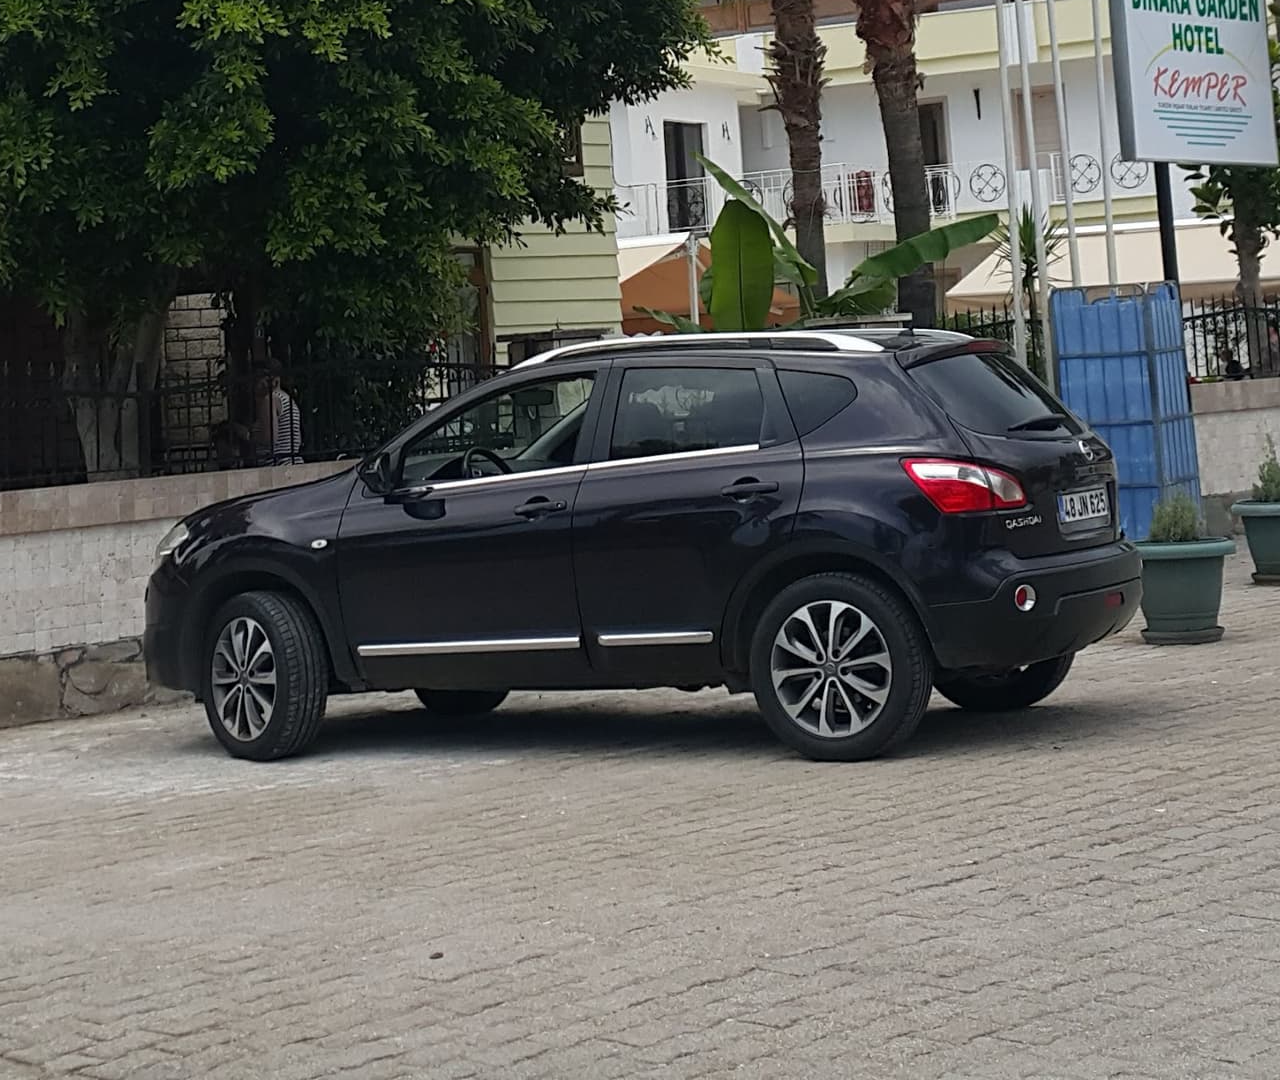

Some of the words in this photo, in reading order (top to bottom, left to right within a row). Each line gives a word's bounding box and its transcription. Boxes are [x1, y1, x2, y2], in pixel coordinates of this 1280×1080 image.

[1172, 23, 1224, 55] HOTEL
[1153, 66, 1247, 107] KEMPER
[1065, 496, 1076, 518] 48
[1090, 492, 1106, 514] 625
